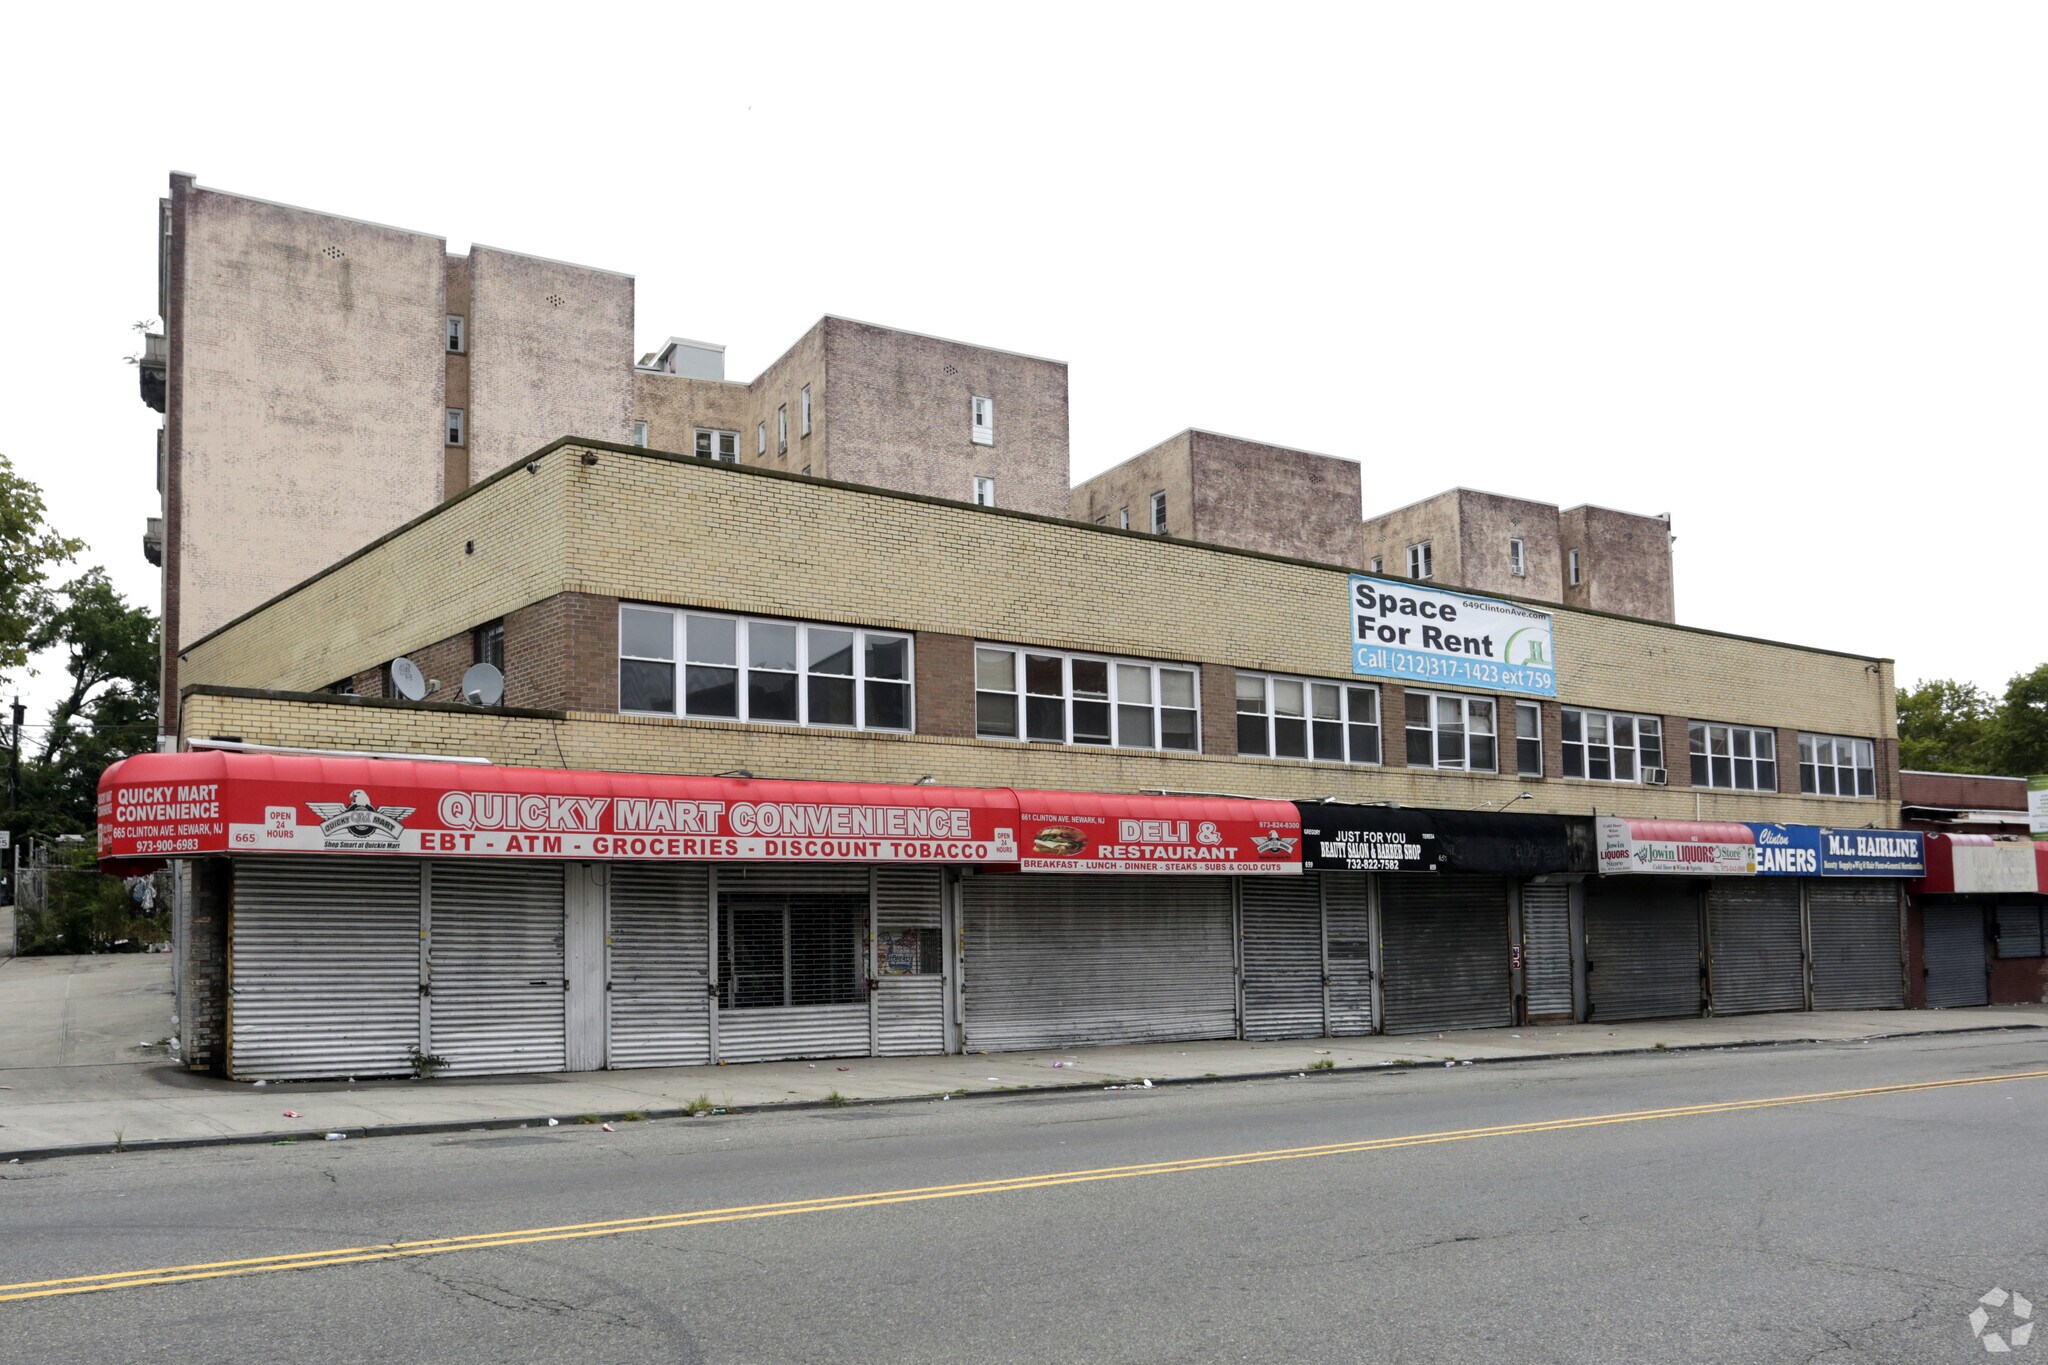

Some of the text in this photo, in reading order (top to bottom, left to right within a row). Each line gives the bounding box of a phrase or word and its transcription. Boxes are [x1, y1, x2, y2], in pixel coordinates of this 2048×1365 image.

[1356, 584, 1457, 622] Space
[1462, 600, 1546, 620] 649ClintonAve.com
[1358, 615, 1494, 657] For Rent
[1358, 648, 1551, 689] Call (212)317-1423 ext 759
[118, 786, 174, 805] QUICKY
[178, 784, 218, 802] MART
[116, 802, 219, 822] CONVENIENCE
[270, 812, 291, 820] OPEN
[438, 791, 971, 839] QUICKY MART CONVENIENCE
[1032, 814, 1057, 822] CLINTON
[1072, 816, 1097, 824] NEWARK,
[113, 823, 223, 838] 665 CLINTON AVE. NEWARK, NJ
[324, 816, 350, 832] QUICKY
[372, 816, 396, 832] MART
[1119, 819, 1222, 845] DELI &
[235, 834, 255, 842] 665
[266, 830, 294, 838] HOURS
[1335, 831, 1406, 843] JUST FOR YOU
[1759, 828, 1789, 845] Clinton
[136, 839, 199, 852] 973-900-6983
[420, 832, 476, 851] EBT
[506, 835, 562, 853] ATM
[593, 837, 738, 855] GROCERIES
[765, 840, 882, 858] DISCOUNT
[891, 842, 988, 859] TOBACCO
[1098, 845, 1238, 859] RESTAURANT
[1320, 841, 1346, 858] BEAUTY
[1347, 842, 1369, 858] SALON
[1370, 845, 1376, 859] &
[1376, 844, 1403, 859] BARBER
[1404, 844, 1421, 860] SHOP
[1606, 841, 1624, 850] Jowin
[1648, 844, 1675, 862] Jowin
[1676, 845, 1715, 864] LIQUORS
[1722, 847, 1740, 858] Store
[1829, 835, 1918, 858] M.L. HAIRLINE
[1600, 849, 1630, 860] LIQUORS
[1756, 848, 1817, 872] EANERS
[1024, 860, 1078, 868] BREAKFAST
[1086, 861, 1117, 869] LUNCH
[1125, 862, 1157, 870] DINNER
[1165, 863, 1197, 871] STEAKS
[1204, 863, 1226, 871] SUBS
[1346, 859, 1399, 870] 732-822-7582
